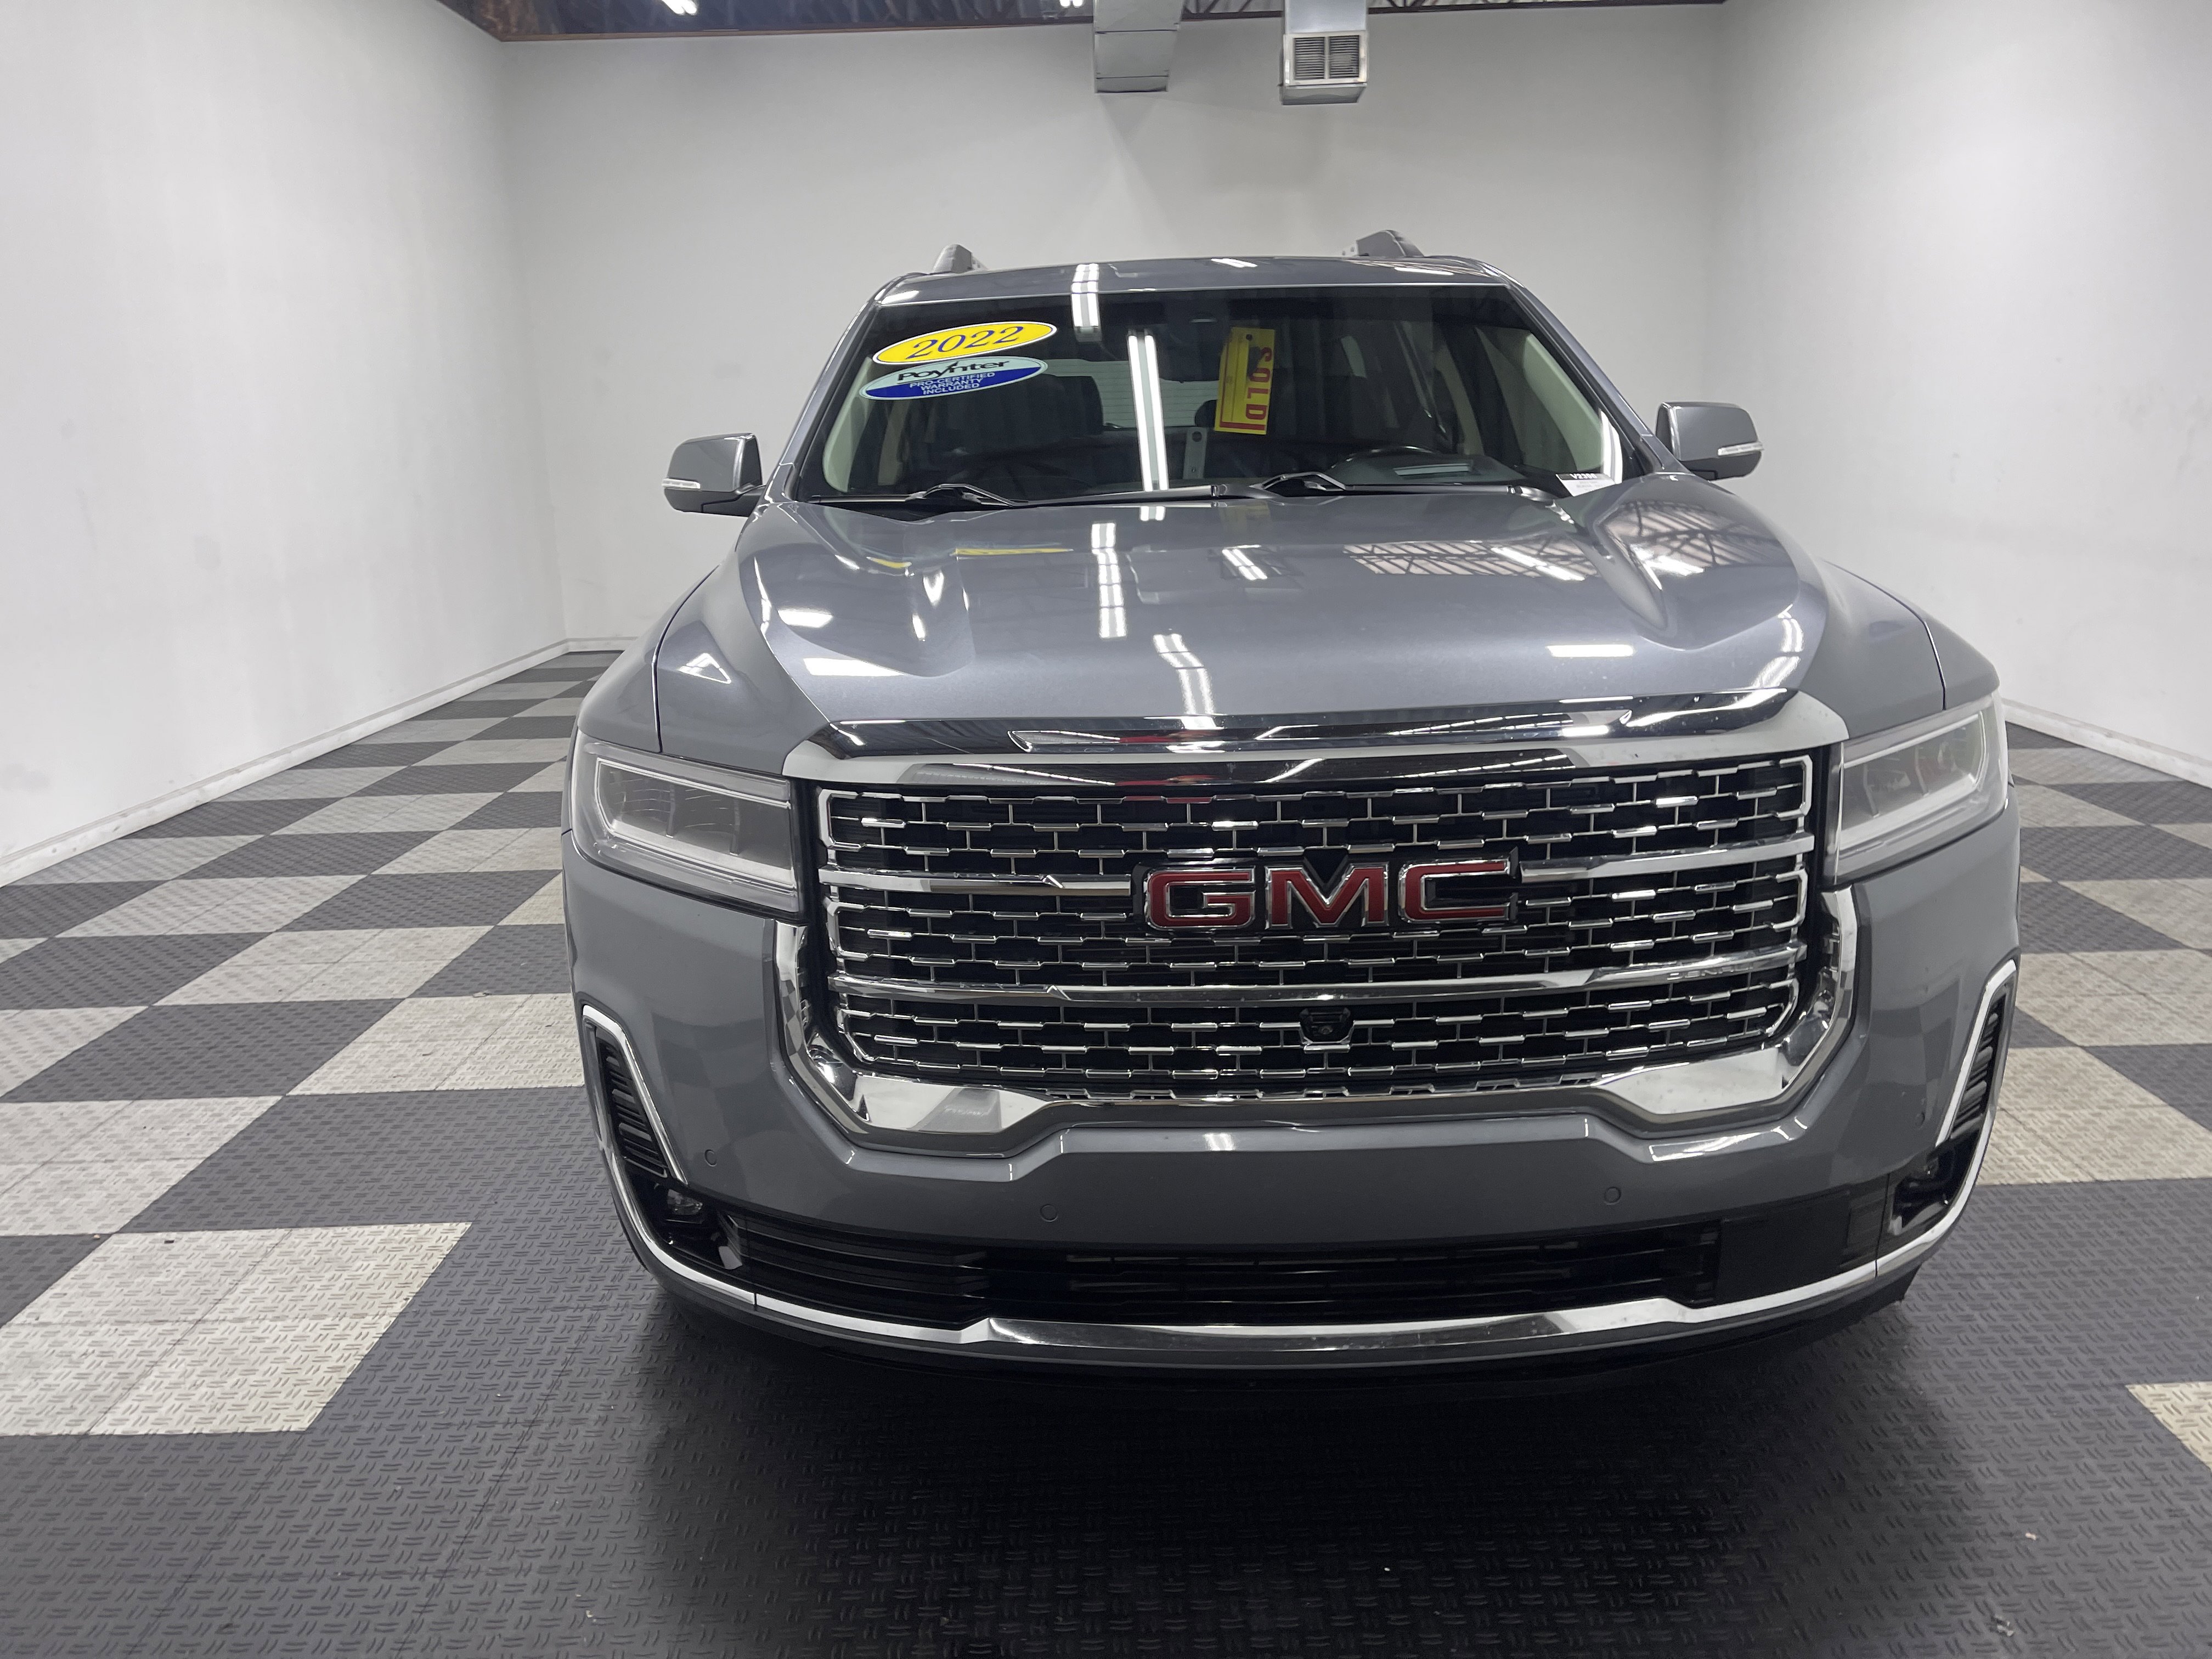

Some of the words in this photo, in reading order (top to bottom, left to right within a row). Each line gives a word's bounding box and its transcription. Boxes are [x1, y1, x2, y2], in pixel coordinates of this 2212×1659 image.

[905, 326, 1024, 359] 2022
[896, 360, 1010, 381] Poynter
[909, 372, 996, 388] PRO-CERTIFIED
[921, 377, 984, 391] WARRANTY
[923, 382, 980, 395] INCLUDED
[1142, 857, 1513, 932] GMC
